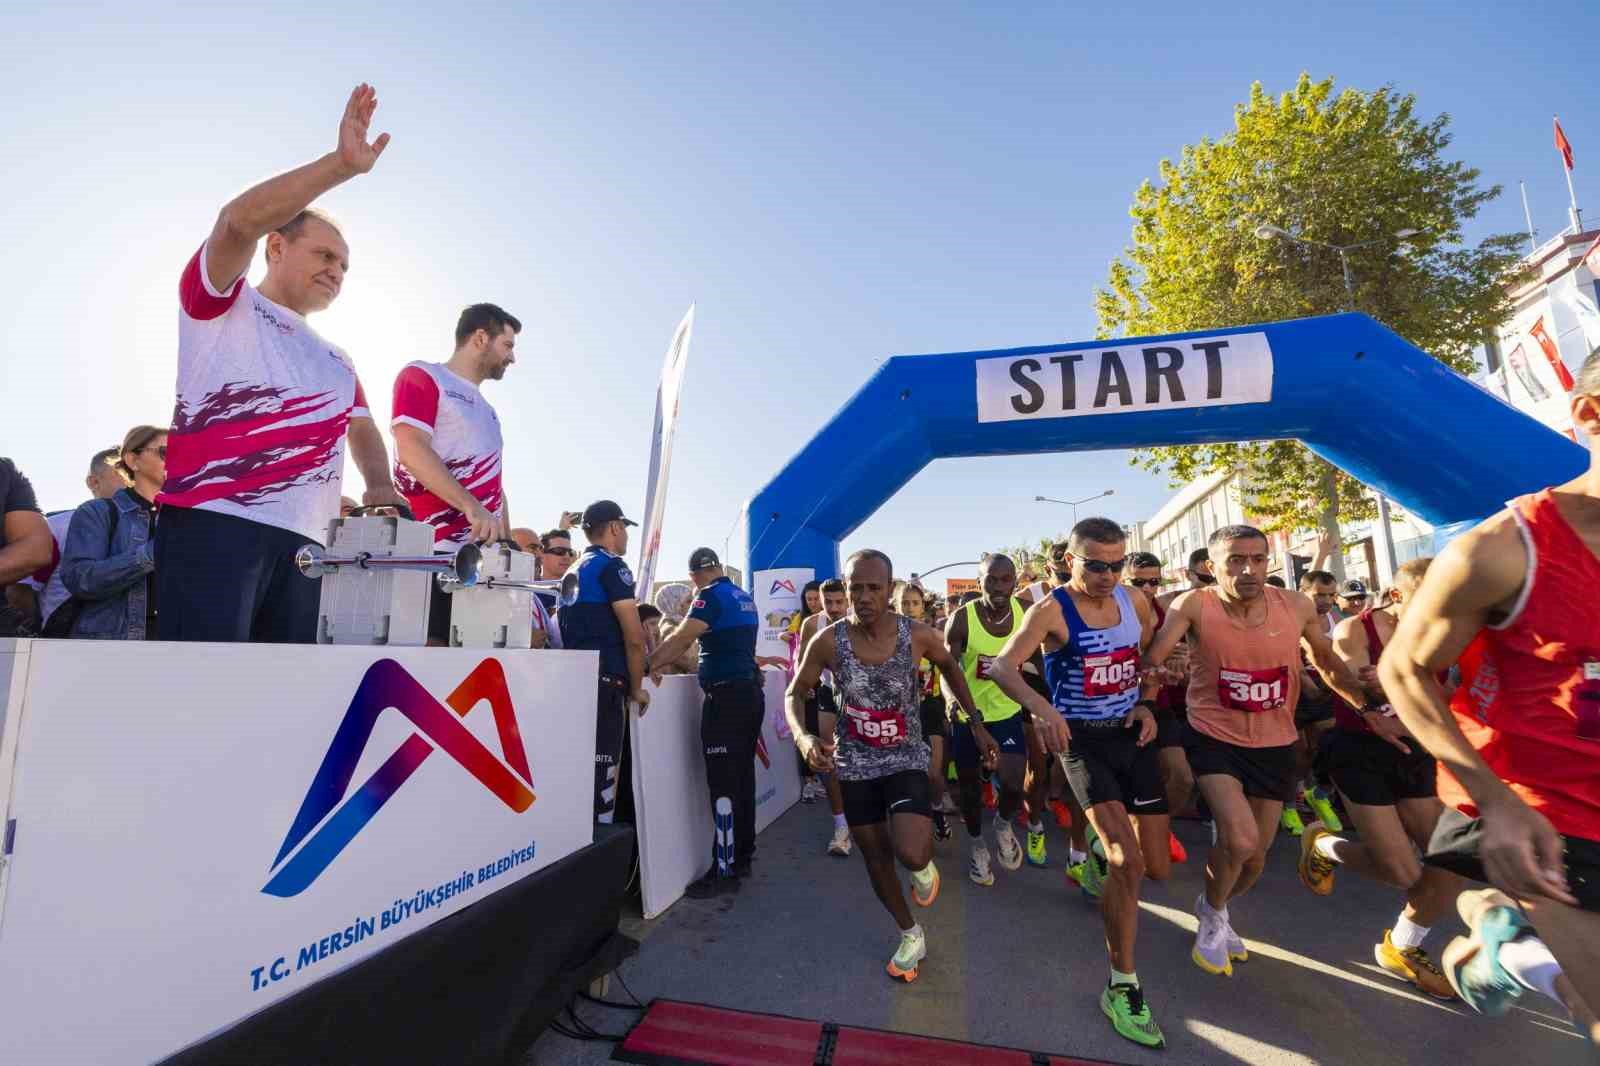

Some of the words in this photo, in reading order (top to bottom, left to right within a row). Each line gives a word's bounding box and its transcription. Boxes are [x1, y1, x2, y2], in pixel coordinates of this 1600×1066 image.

[1009, 340, 1229, 415] START
[1090, 659, 1136, 686] 405
[1229, 680, 1282, 702] 301
[853, 718, 898, 738] 195
[1083, 720, 1121, 728] NIKE
[250, 957, 291, 991] T.C.
[296, 917, 375, 971] MERSİN
[380, 870, 474, 930] BÜYÜKŞEHİR
[478, 840, 535, 884] BELEDİYESİ
